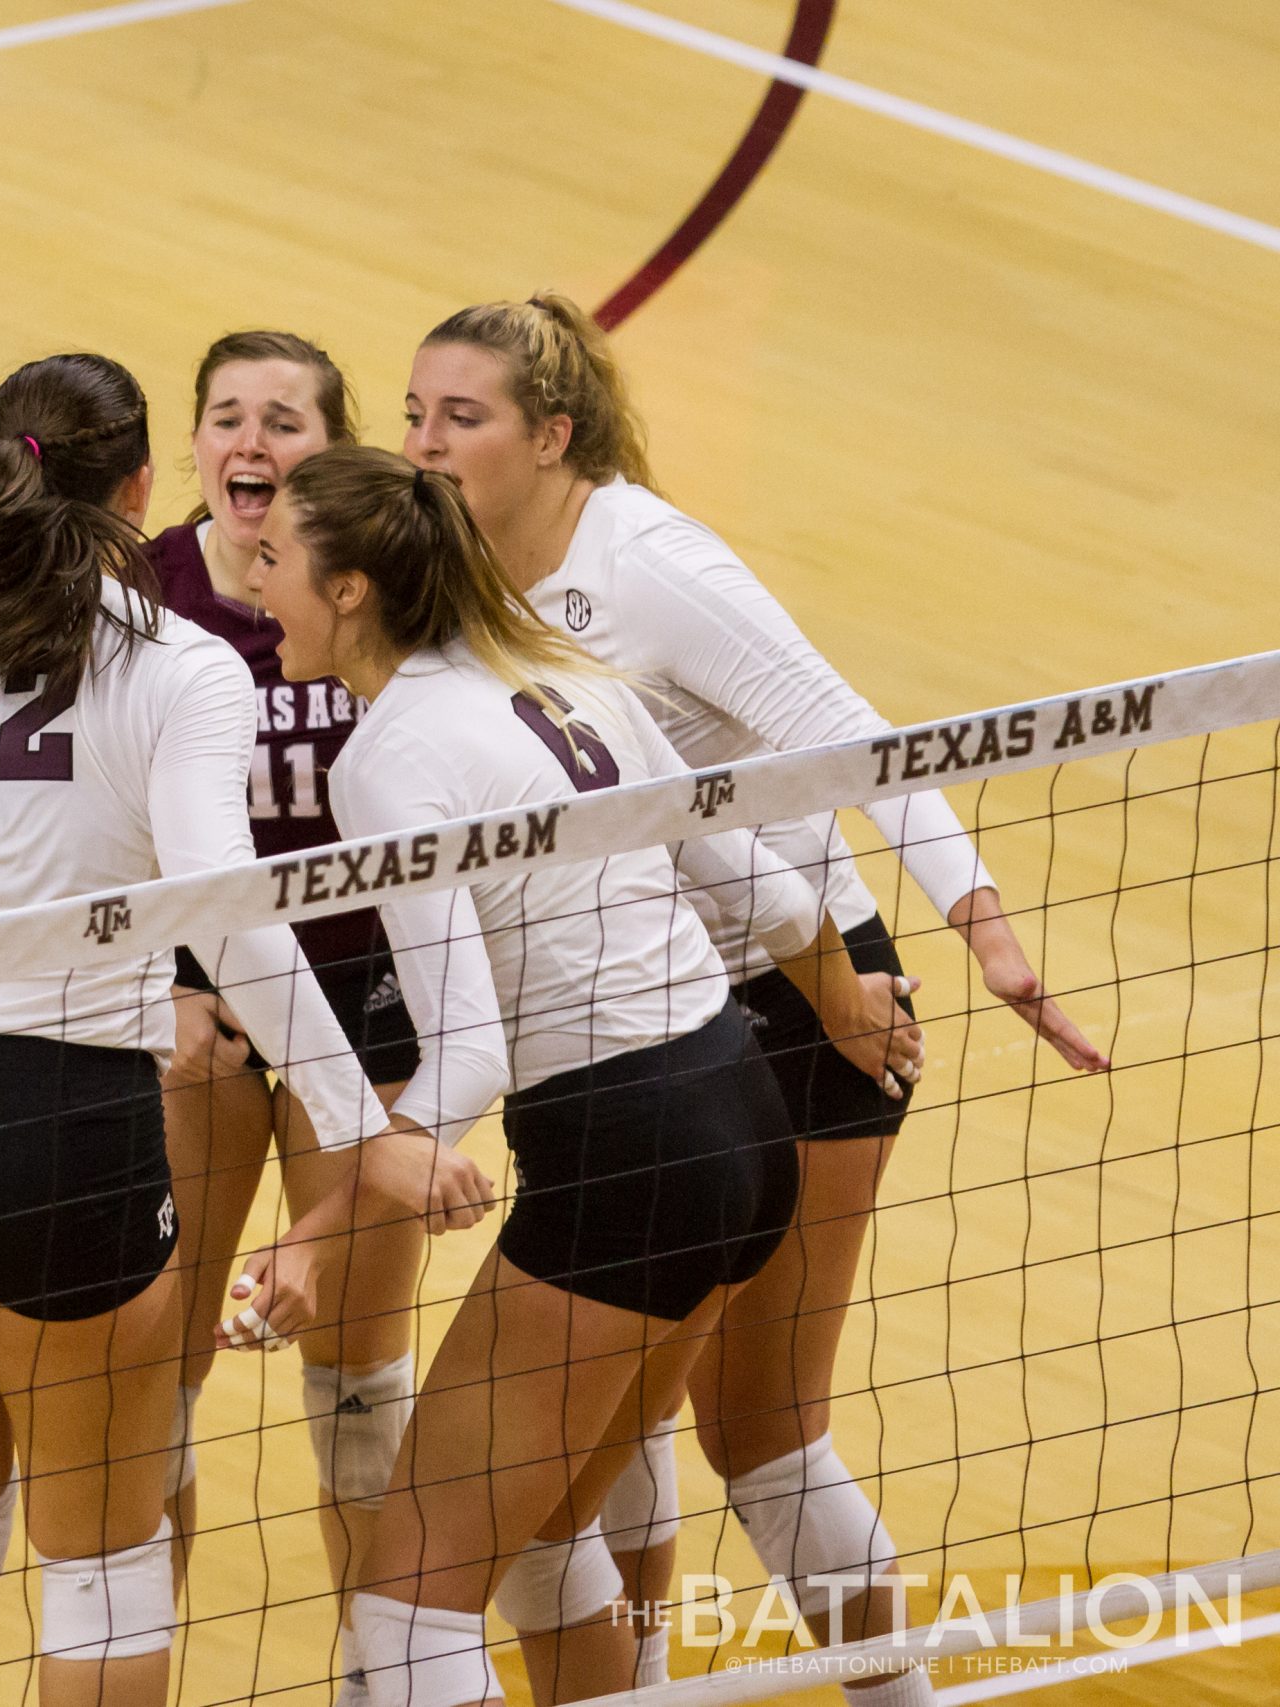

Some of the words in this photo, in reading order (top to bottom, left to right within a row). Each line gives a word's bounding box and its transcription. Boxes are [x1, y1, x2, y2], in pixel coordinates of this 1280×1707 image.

[248, 742, 322, 819] 11
[871, 709, 1037, 787] TEXAS
[1054, 686, 1158, 749] A&M
[270, 832, 440, 911] TEXAS
[456, 809, 561, 873] A&M
